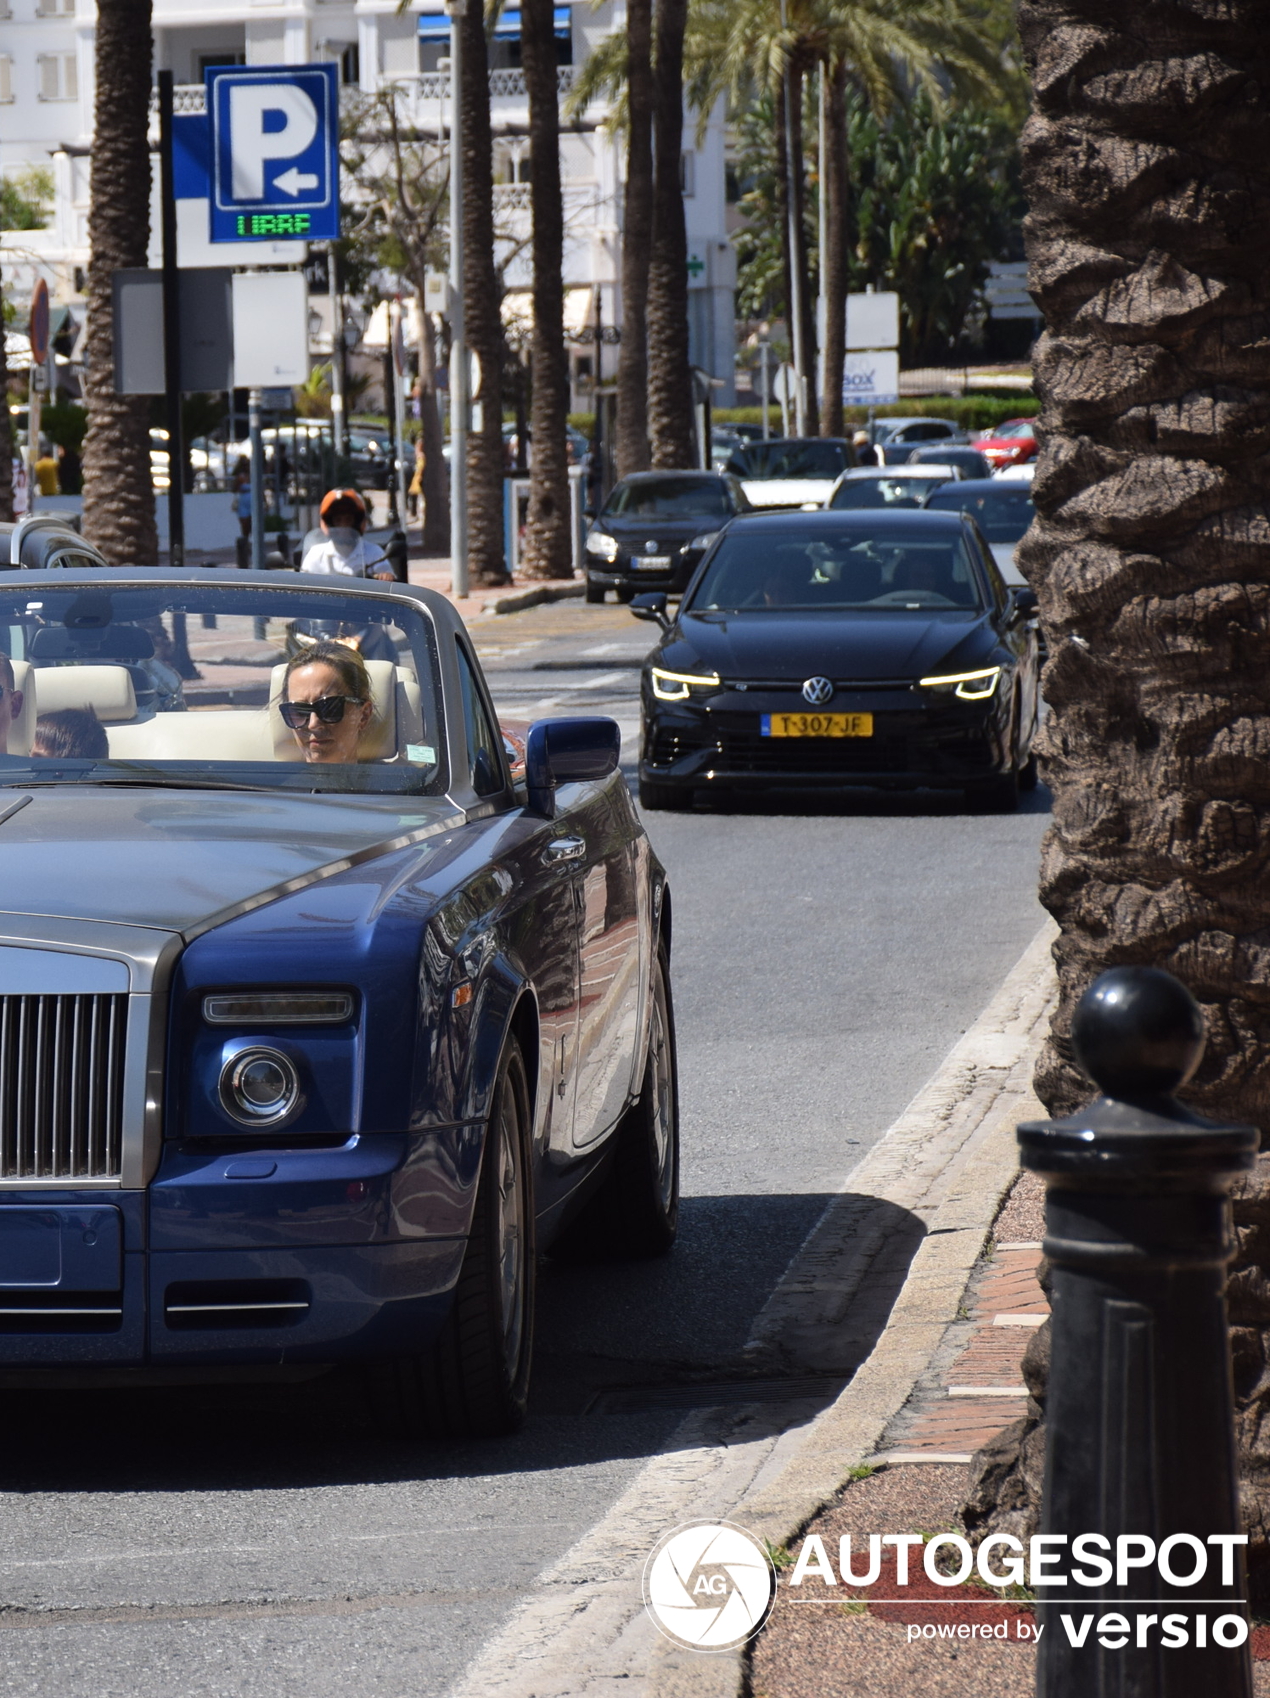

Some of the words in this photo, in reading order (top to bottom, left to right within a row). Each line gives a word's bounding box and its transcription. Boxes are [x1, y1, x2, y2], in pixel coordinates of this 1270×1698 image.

[230, 83, 318, 200] P
[237, 213, 310, 236] LIBRE
[781, 715, 861, 733] T-307-JF
